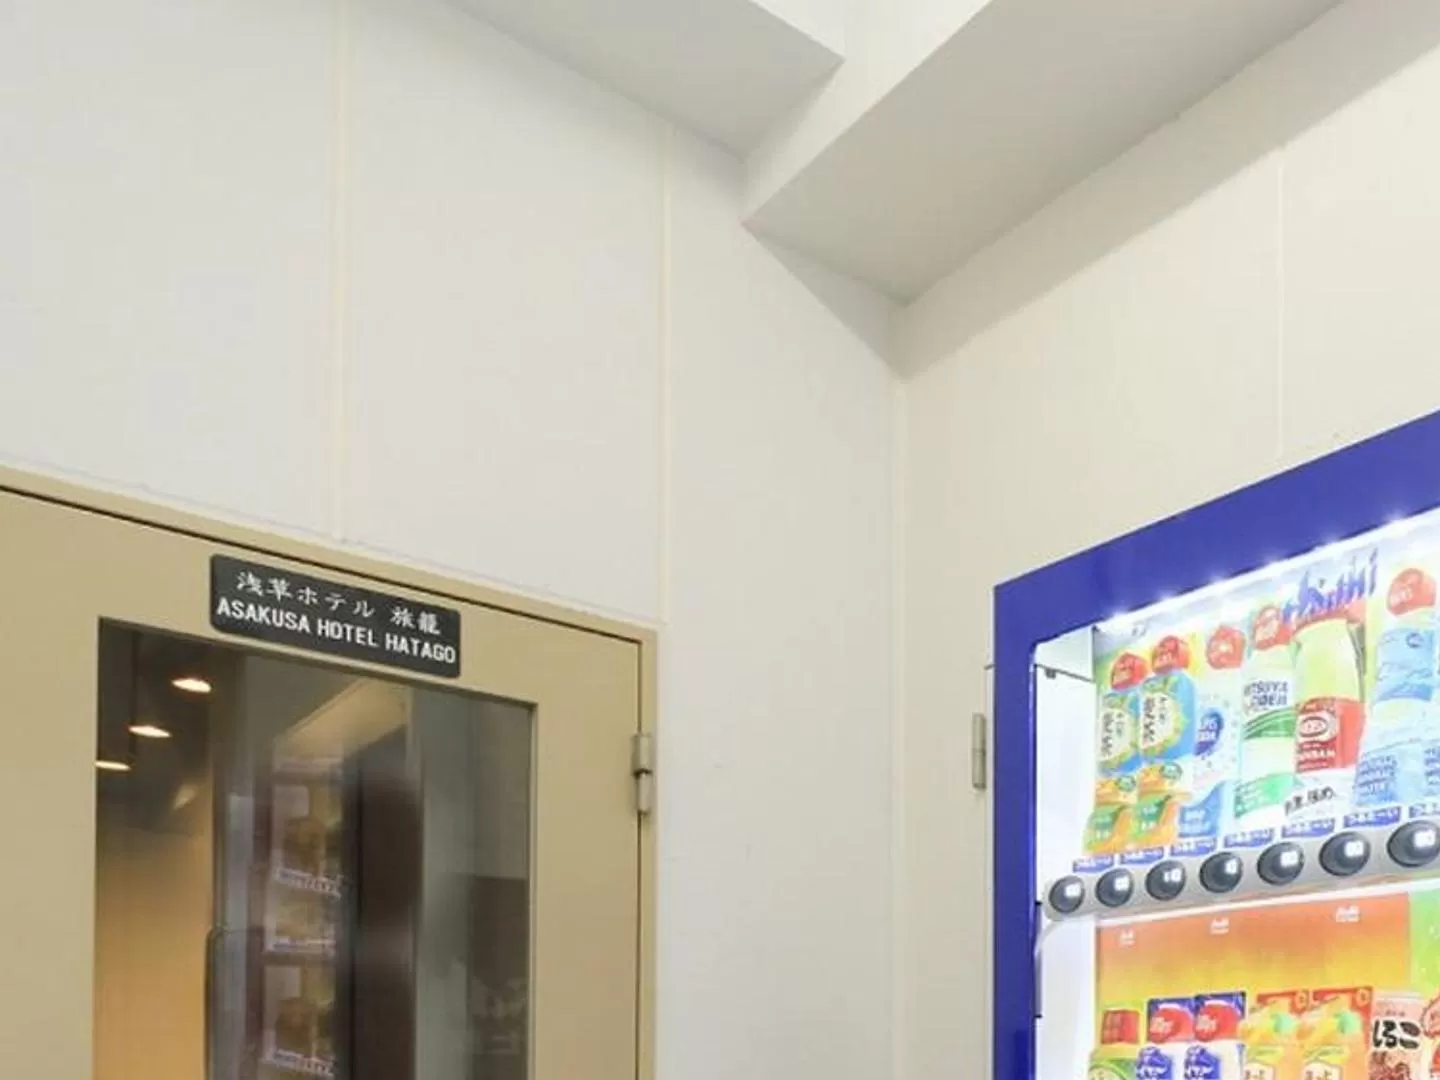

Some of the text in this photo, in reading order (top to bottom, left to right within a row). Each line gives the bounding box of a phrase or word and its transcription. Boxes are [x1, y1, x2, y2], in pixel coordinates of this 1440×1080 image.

[236, 571, 375, 619] 浅草ホテル
[216, 596, 456, 664] ASAKUSA HOTEL HATAGO
